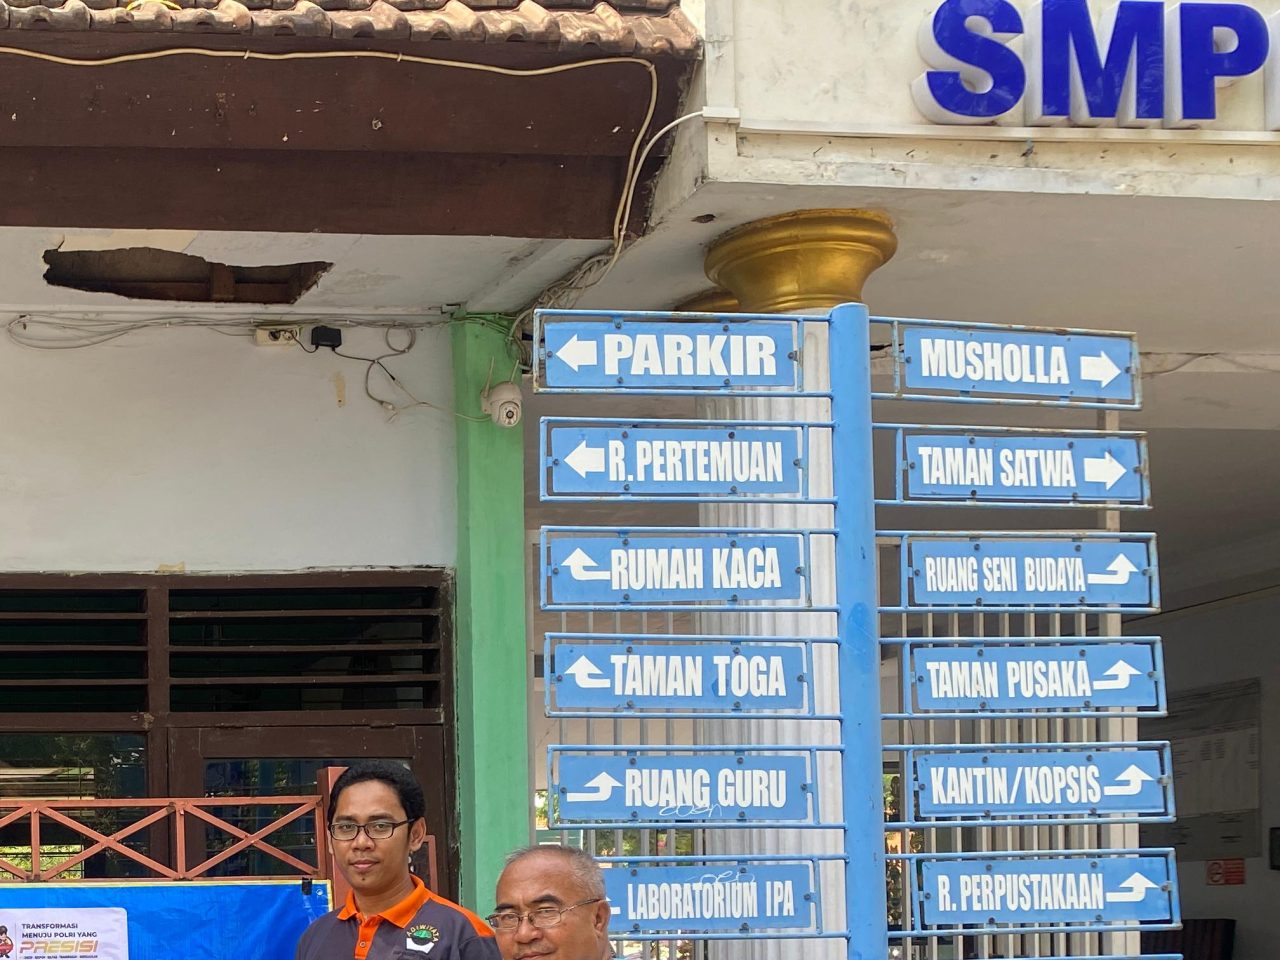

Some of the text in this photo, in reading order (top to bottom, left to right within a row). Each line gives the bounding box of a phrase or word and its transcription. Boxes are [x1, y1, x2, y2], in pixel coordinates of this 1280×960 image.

[926, 0, 1270, 120] SMP
[604, 334, 777, 376] PARKIR
[920, 338, 1070, 385] MUSHOLLA
[918, 446, 1077, 488] TAMAN SATWA
[611, 547, 782, 590] RUMAH KACA
[925, 556, 1086, 592] RUANG SENI BUDAYA
[610, 654, 787, 697] TAMAN TOGA
[926, 659, 1092, 699] TAMAN PUSAKA
[625, 768, 787, 809] RUANG GURU
[930, 764, 1102, 805] KANTIN/KOPSIS
[628, 880, 795, 920] LABORATORIUM IPA
[19, 940, 99, 954] PRESISI
